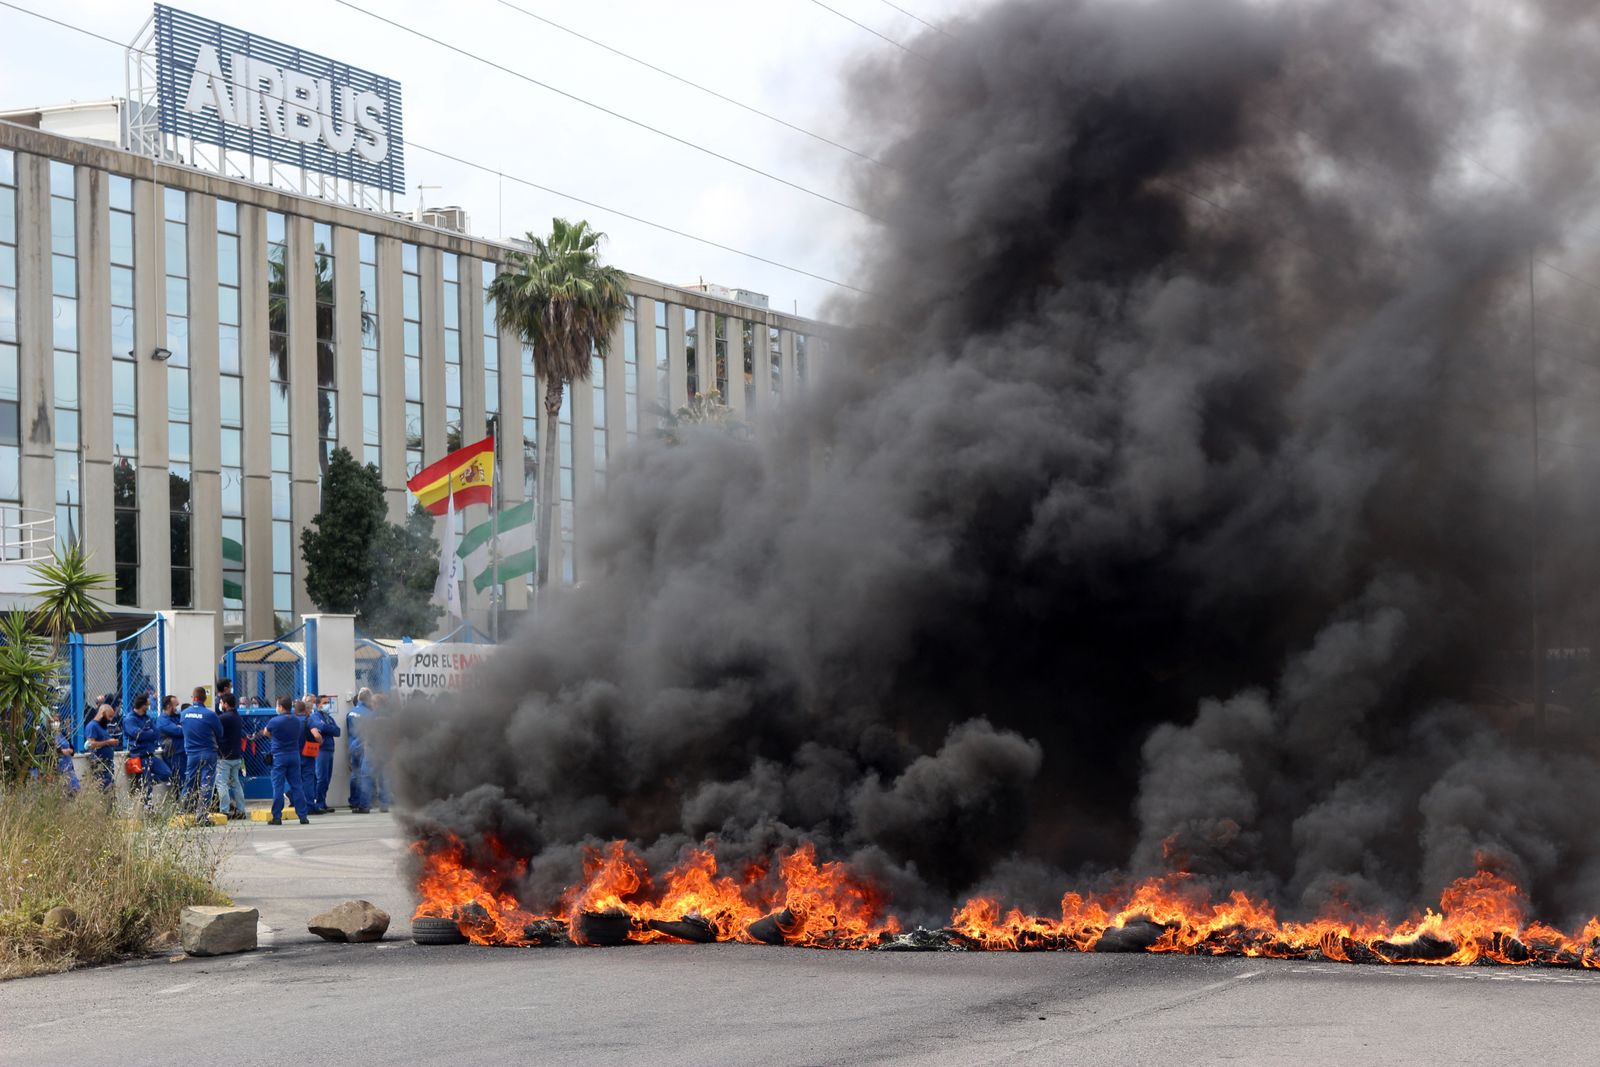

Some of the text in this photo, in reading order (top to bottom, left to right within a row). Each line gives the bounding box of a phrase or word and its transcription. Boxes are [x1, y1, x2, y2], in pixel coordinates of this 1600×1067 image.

[184, 43, 389, 163] AIRBUS
[414, 653, 439, 668] POR
[441, 653, 452, 668] EL
[398, 673, 447, 688] FUTURO
